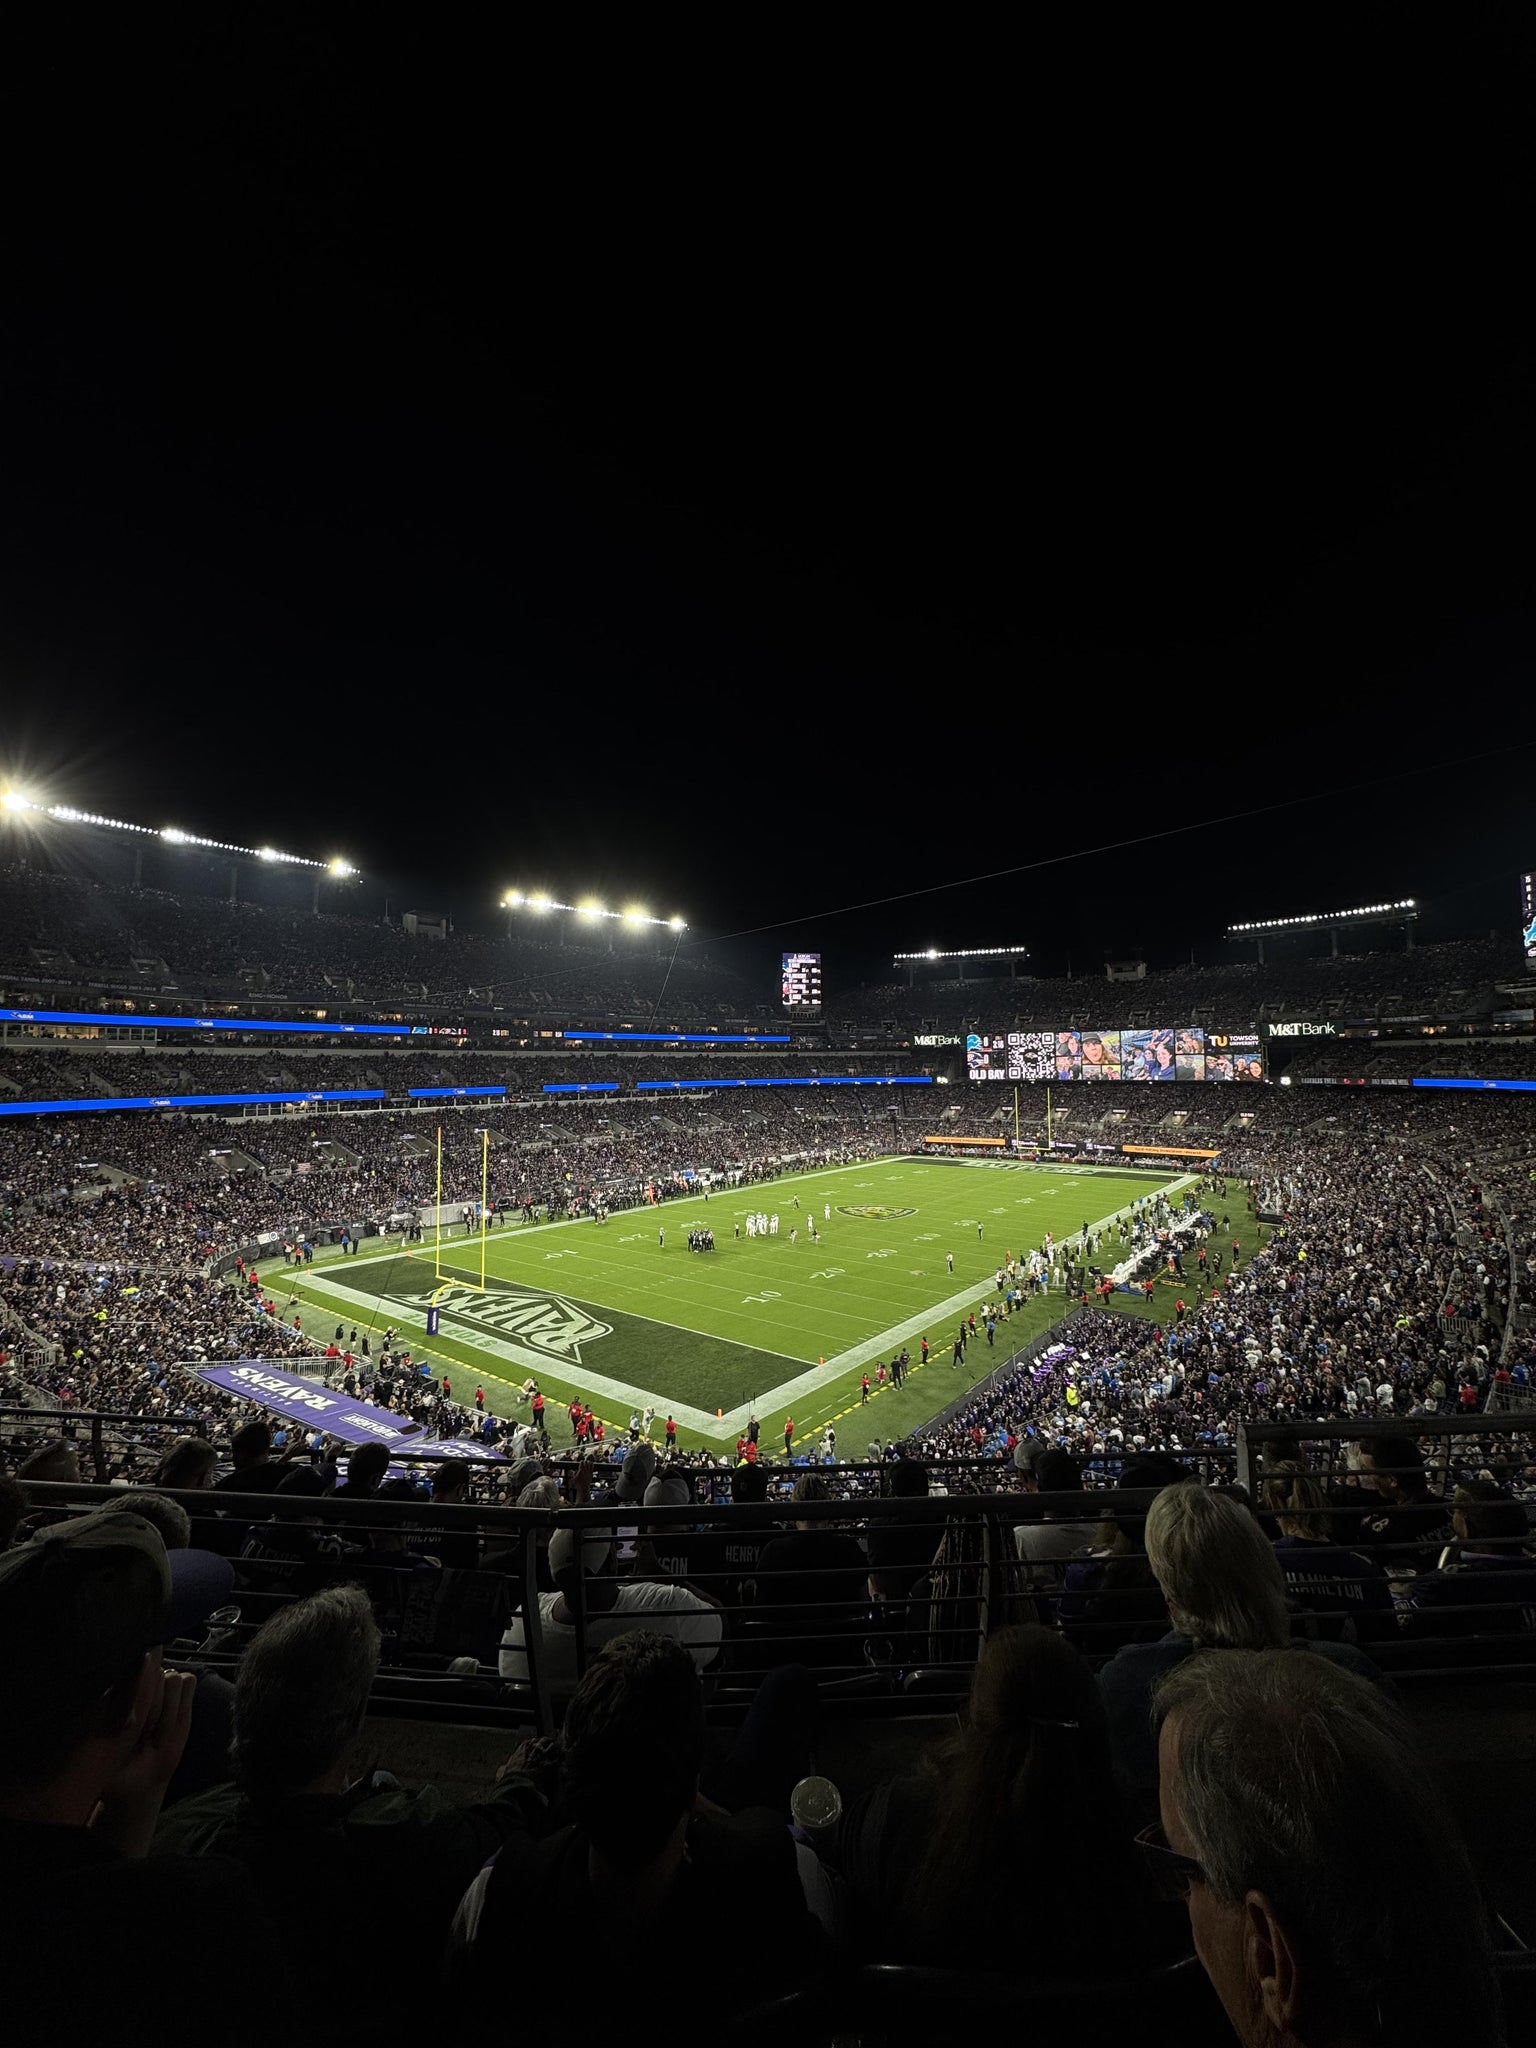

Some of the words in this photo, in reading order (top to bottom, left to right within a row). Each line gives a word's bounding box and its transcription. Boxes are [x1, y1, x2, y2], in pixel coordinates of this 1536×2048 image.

[1269, 1023, 1301, 1036] M&T
[1302, 1022, 1335, 1035] Bank
[914, 1035, 937, 1046] M&T
[938, 1035, 961, 1045] Bank
[969, 1069, 986, 1080] OLD
[988, 1069, 1005, 1080] BAY
[395, 1288, 609, 1355] RAVENS
[229, 1366, 340, 1411] RAVENS
[725, 1545, 760, 1563] HENRY
